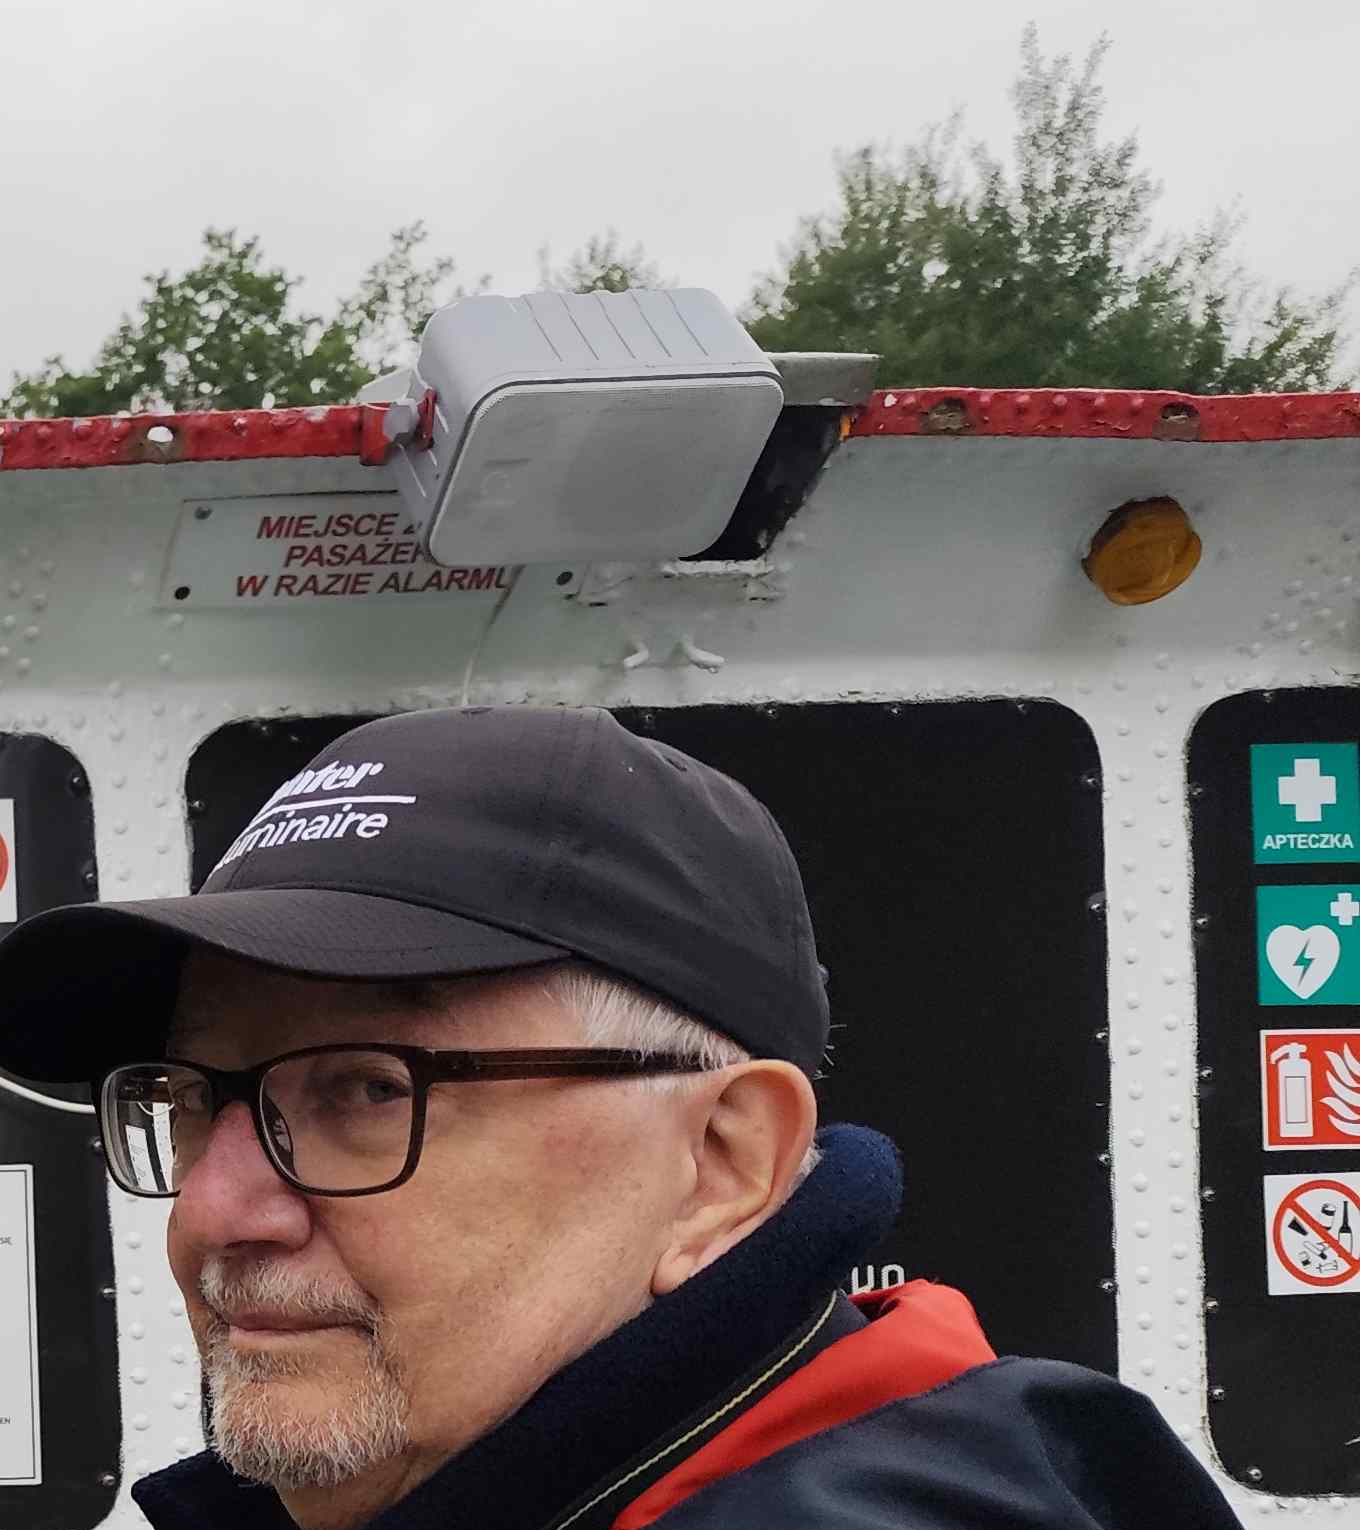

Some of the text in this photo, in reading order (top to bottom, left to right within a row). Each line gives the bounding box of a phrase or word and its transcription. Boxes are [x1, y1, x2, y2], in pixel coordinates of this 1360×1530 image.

[256, 513, 399, 540] MIEJSCE
[235, 575, 268, 596] W
[274, 572, 374, 597] RAZIE
[1262, 833, 1355, 850] APTECZKA
